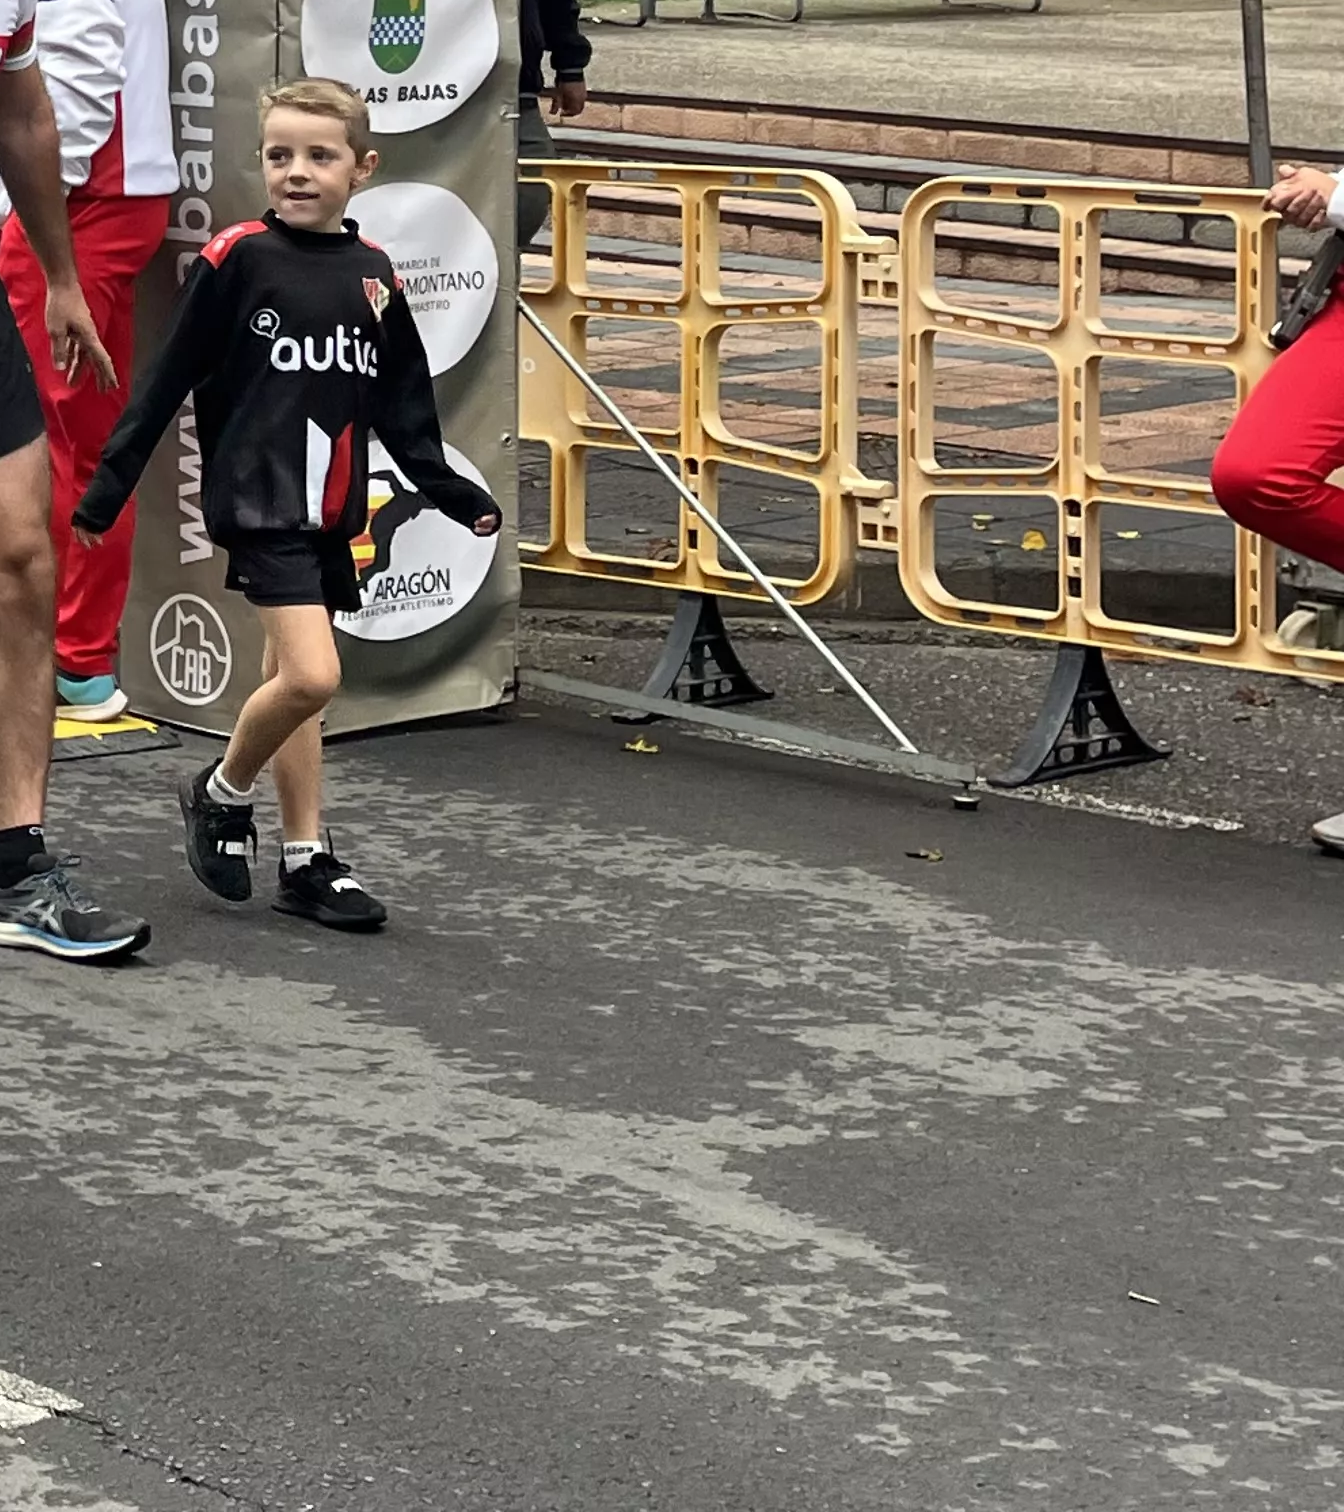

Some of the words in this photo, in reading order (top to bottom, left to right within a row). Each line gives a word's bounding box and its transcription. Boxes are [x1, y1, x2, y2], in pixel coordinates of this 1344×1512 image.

[362, 87, 389, 104] AS
[397, 83, 459, 103] BAJAS
[404, 271, 486, 297] MONTANO
[372, 563, 452, 603] ARAGÓN
[399, 597, 454, 612] ATLETISMO
[170, 644, 213, 695] CAB
